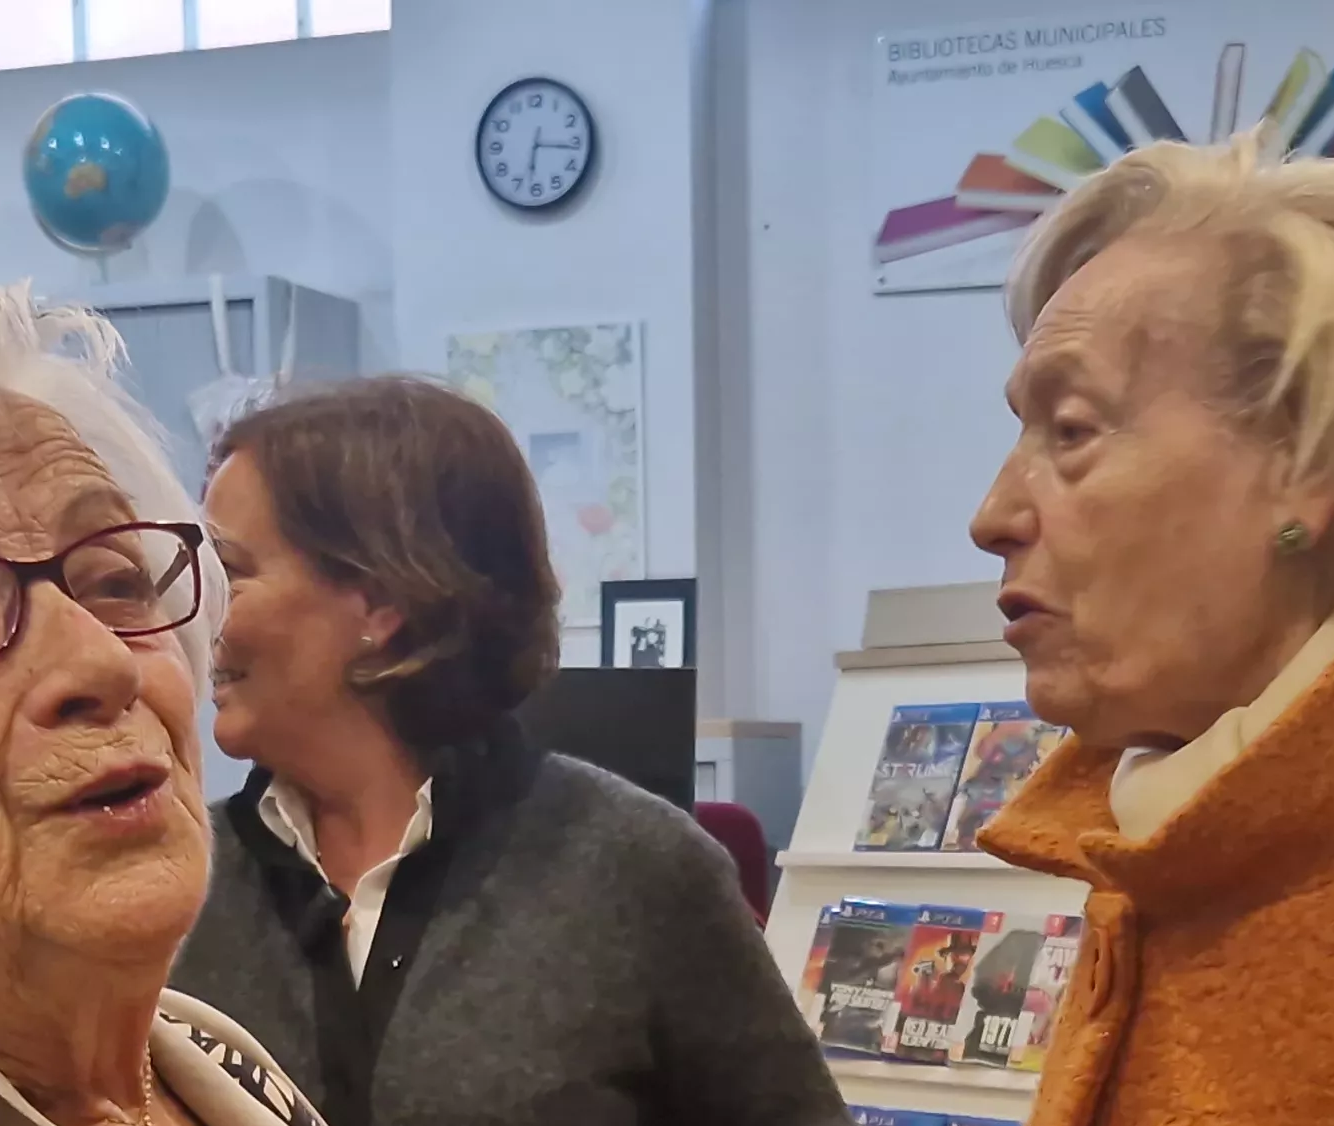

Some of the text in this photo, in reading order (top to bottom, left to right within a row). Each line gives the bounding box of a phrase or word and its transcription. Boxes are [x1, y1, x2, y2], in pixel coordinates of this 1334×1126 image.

[888, 17, 1165, 62] BIBLIOTECAS MUNICIPALES
[997, 61, 1018, 76] de
